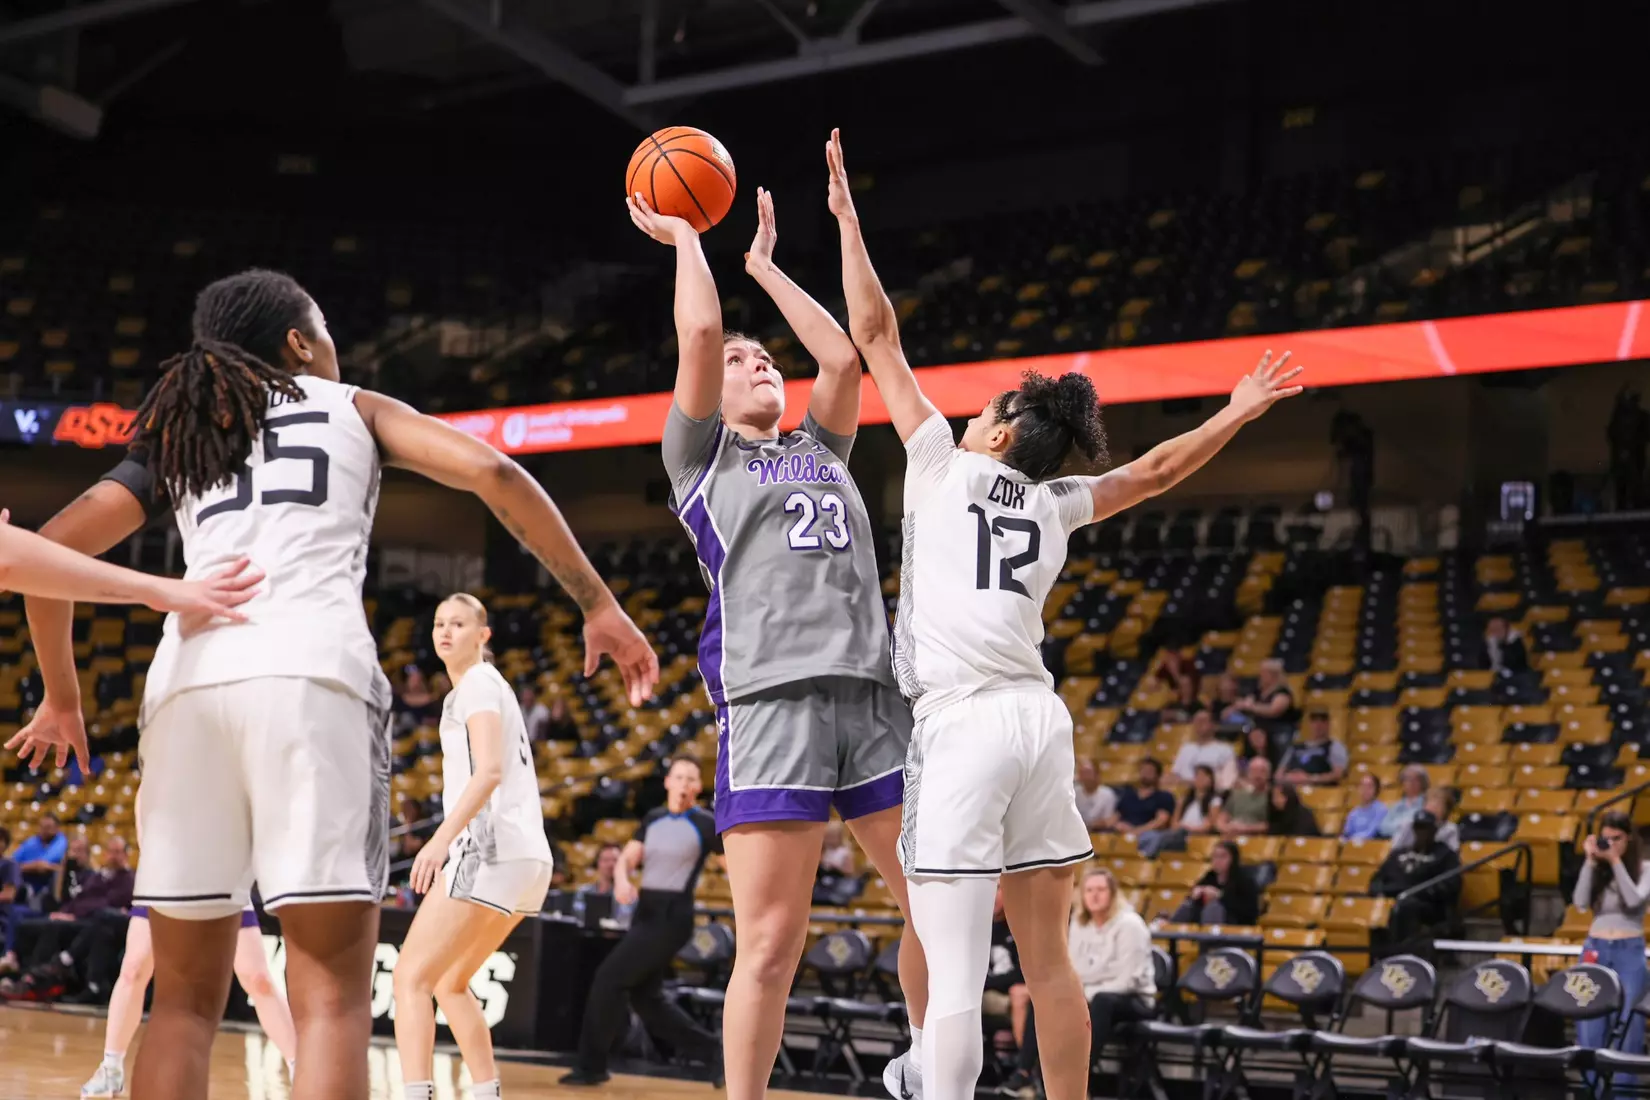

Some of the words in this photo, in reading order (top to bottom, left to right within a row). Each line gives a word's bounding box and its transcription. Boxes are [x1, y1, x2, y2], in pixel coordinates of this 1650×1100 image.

[784, 492, 851, 551] 23
[988, 474, 1025, 510] COX
[968, 503, 1041, 601] 12
